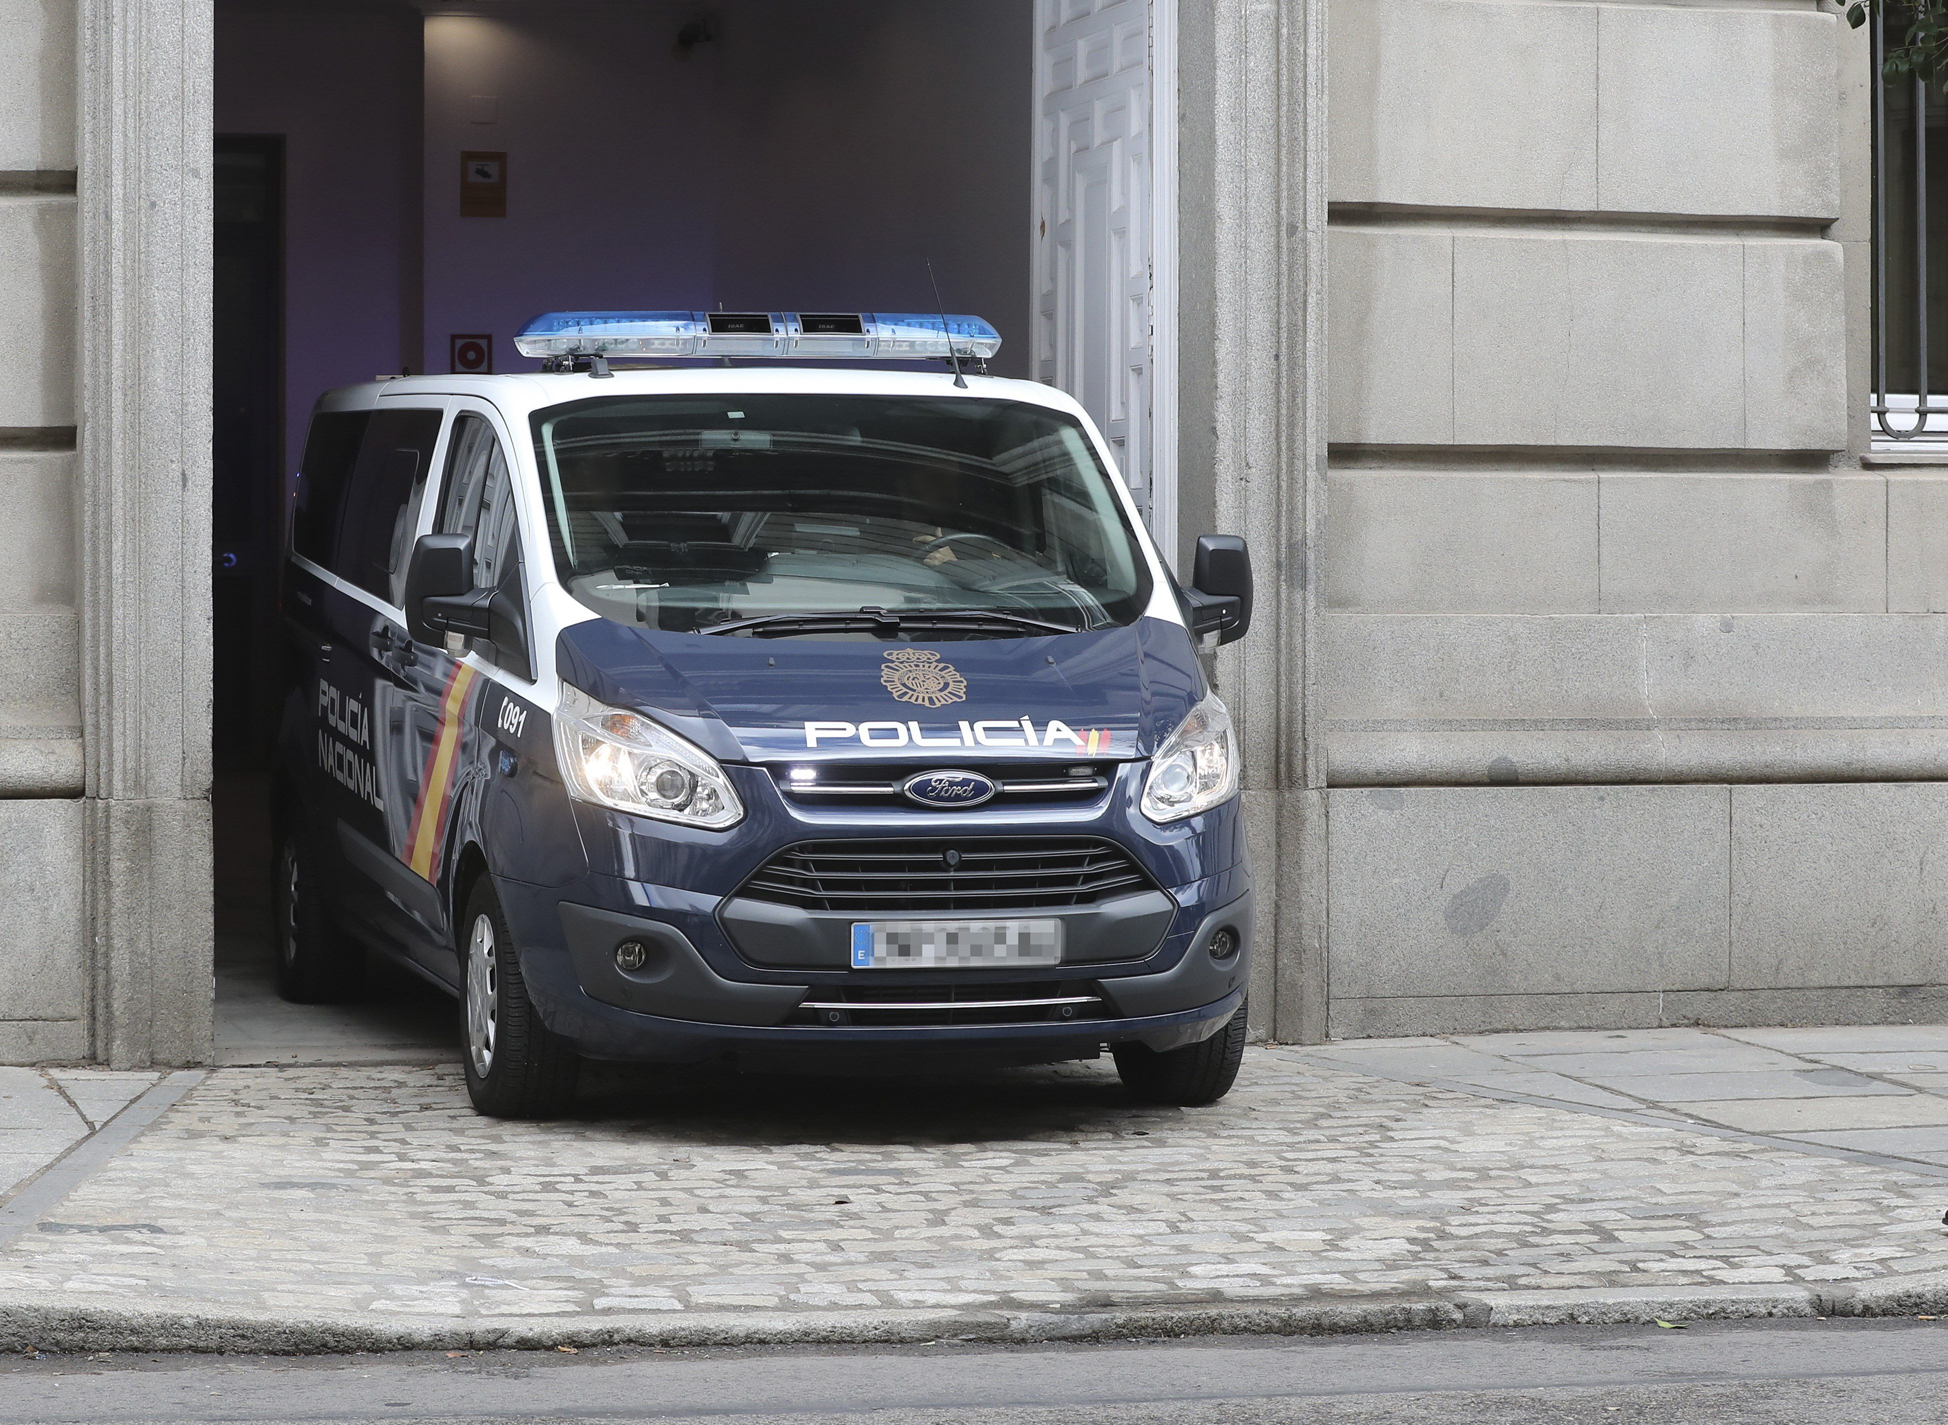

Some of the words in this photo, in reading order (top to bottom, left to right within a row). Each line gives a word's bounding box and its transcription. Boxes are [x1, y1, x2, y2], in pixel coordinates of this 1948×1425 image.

[319, 678, 369, 750] POLICÍA
[503, 702, 527, 738] 091
[803, 714, 1086, 748] POLICÍA
[318, 728, 384, 812] NACIONAL
[926, 776, 975, 798] Ford
[857, 950, 866, 960] E
